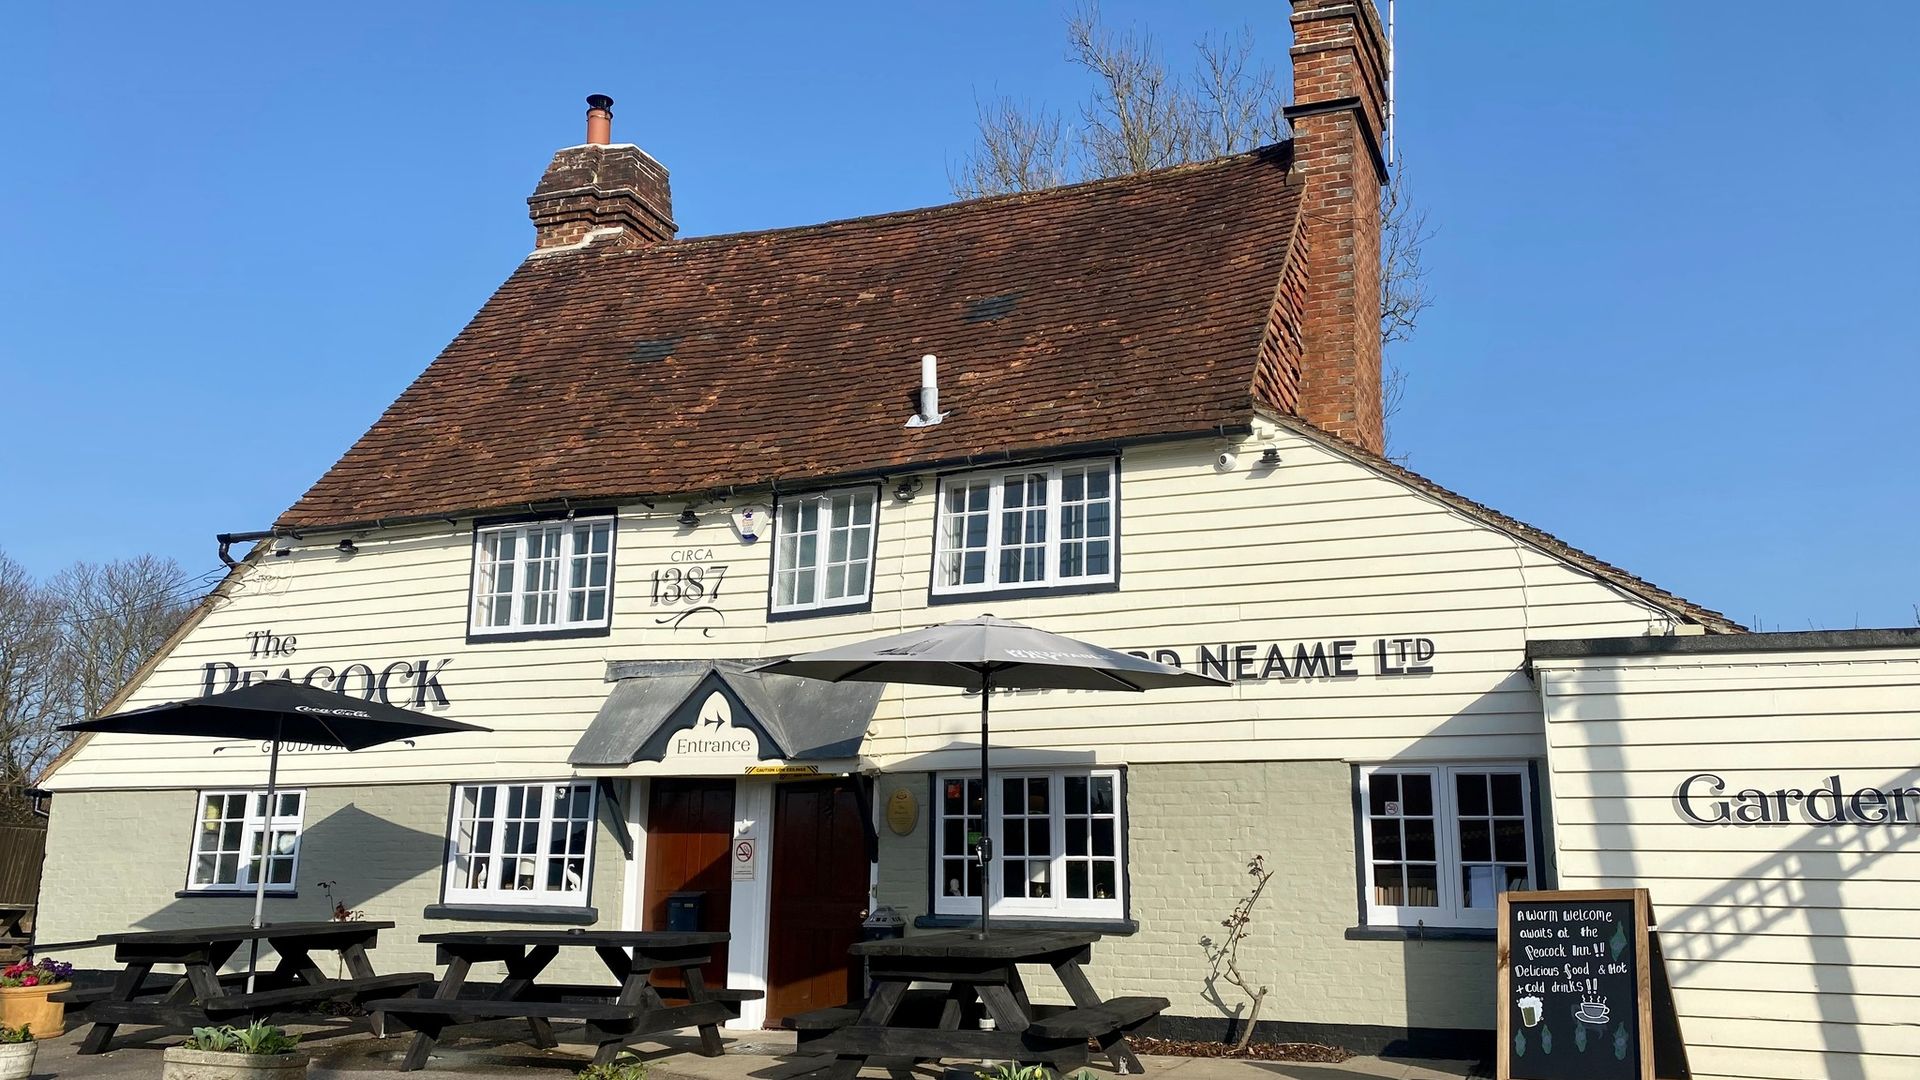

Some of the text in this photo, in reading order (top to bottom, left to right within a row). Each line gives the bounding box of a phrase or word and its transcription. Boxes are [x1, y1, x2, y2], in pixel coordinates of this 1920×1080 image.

[671, 549, 714, 562] CIRCA
[650, 566, 728, 607] 1387
[247, 629, 297, 659] The
[1198, 640, 1358, 682] NEAME
[1376, 638, 1435, 678] LTD
[294, 705, 371, 718] Coca-Cola
[677, 739, 750, 754] Entrance
[1675, 773, 1920, 825] Garden
[1517, 910, 1525, 921] A
[1519, 926, 1598, 938] awaits at the
[1524, 943, 1567, 960] Peacock
[1514, 961, 1628, 980] Delicious food & Hot
